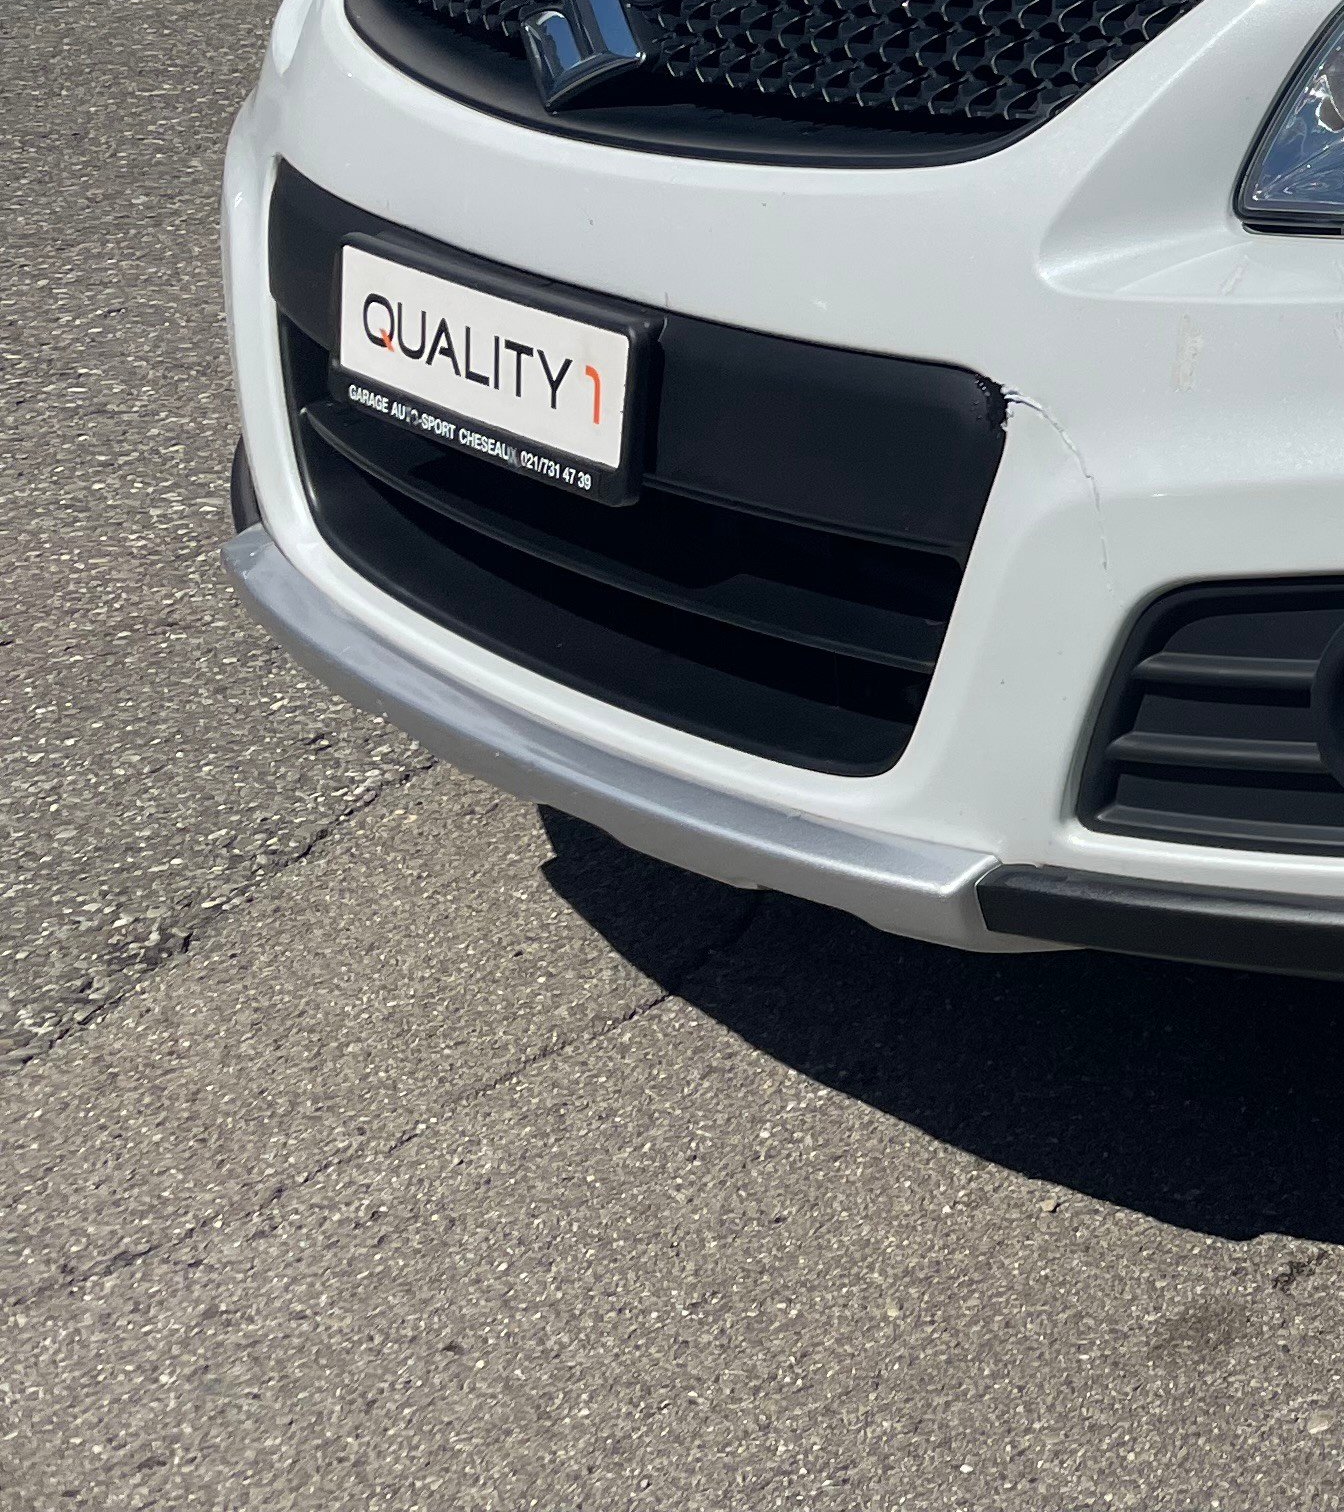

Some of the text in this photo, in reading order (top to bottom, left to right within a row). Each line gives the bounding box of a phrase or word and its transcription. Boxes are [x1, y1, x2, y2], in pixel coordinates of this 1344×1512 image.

[348, 384, 390, 414] GARAGE
[520, 450, 561, 479] 021/731
[562, 467, 577, 484] 47
[577, 472, 592, 490] 39
